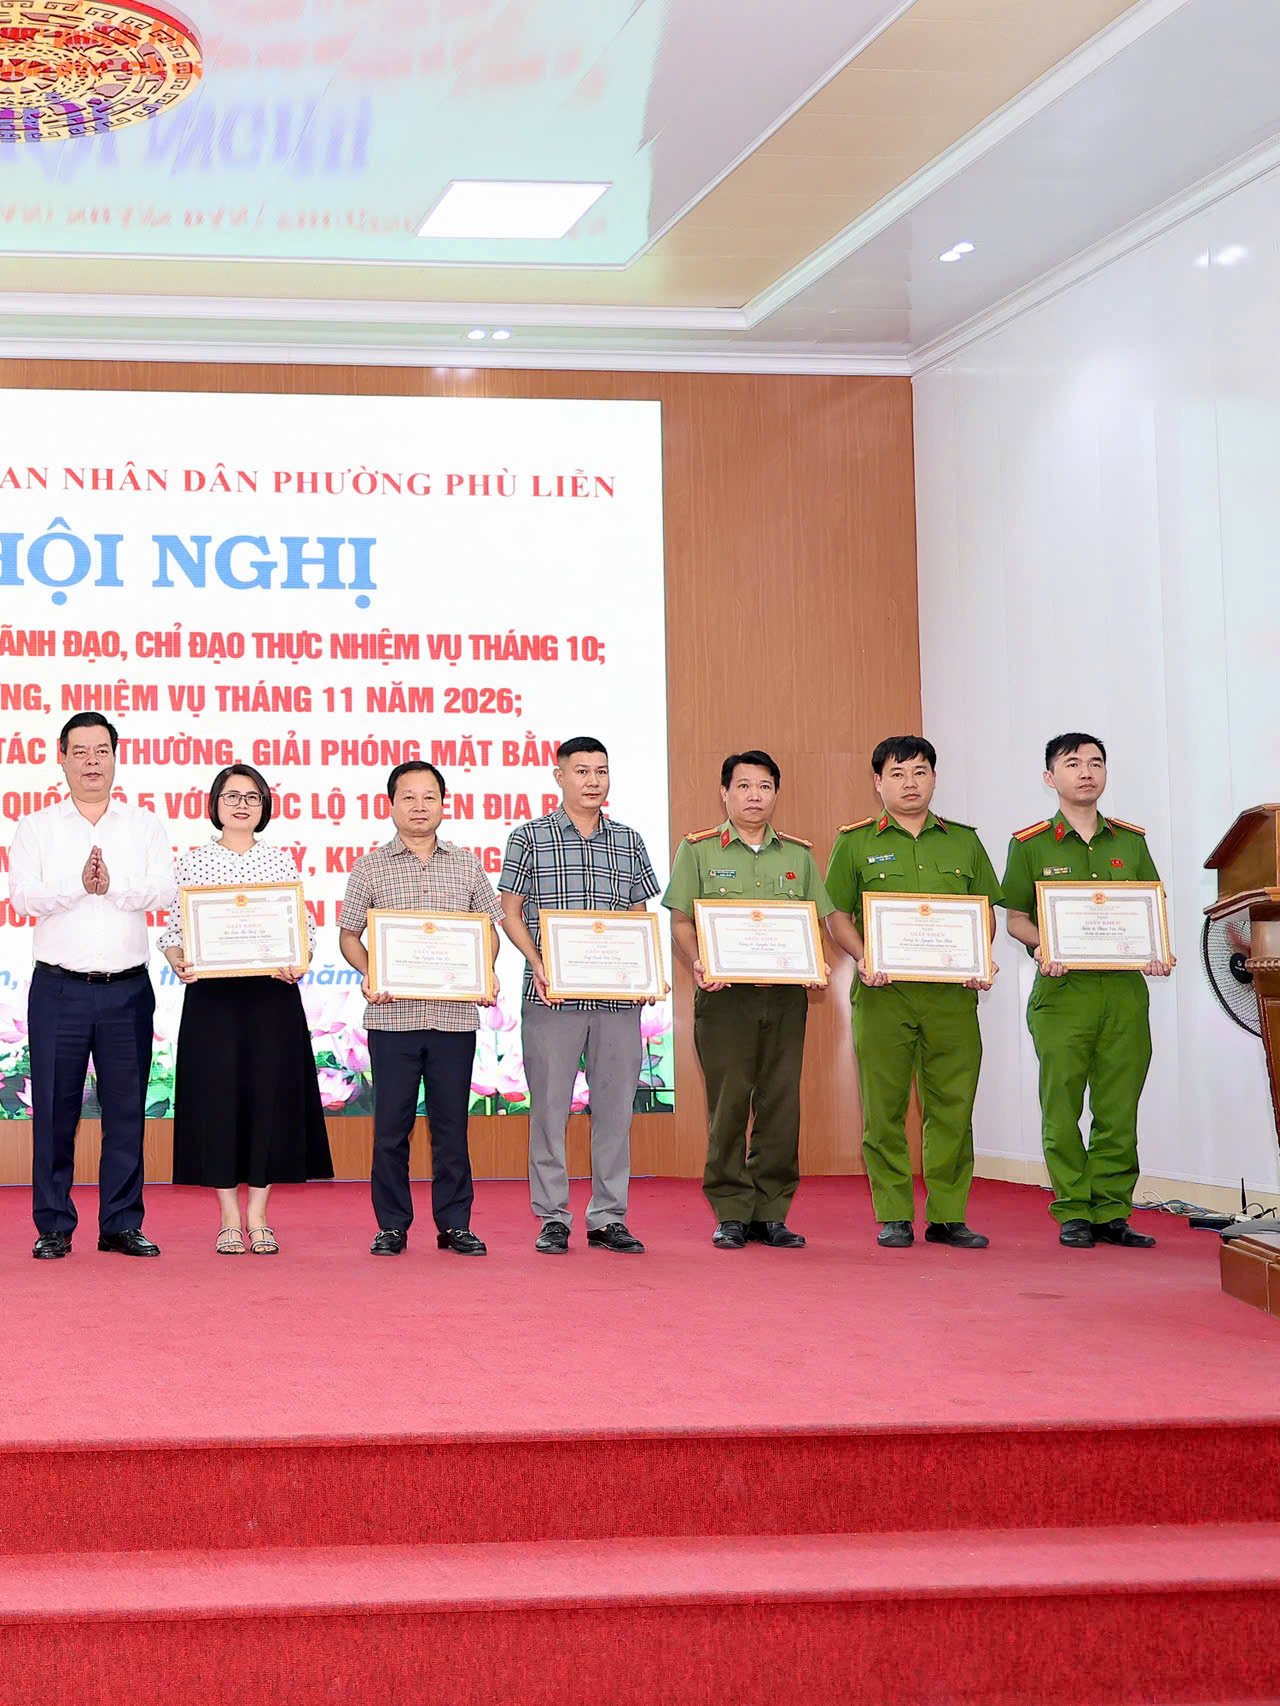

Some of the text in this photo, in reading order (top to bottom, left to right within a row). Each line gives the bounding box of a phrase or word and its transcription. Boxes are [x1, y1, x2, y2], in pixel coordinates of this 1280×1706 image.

[63, 461, 169, 492] NHÂN
[183, 463, 258, 494] DÂN
[273, 465, 432, 496] PHƯỜNG
[446, 467, 518, 497] PHÙ
[152, 535, 376, 608] NGHỊ
[63, 630, 128, 663] ĐẠO,
[136, 622, 182, 658] CHỈ
[189, 632, 245, 664] ĐẠO
[251, 630, 323, 665] THỰC
[330, 628, 420, 666] NHIỆM
[427, 634, 462, 666] VỤ
[468, 629, 558, 661] THÁNG
[566, 636, 606, 664] 10;
[61, 679, 158, 717] NHIỆM
[168, 685, 206, 717] VỤ
[215, 680, 312, 713] THÁNG
[322, 687, 353, 712] 11
[367, 681, 434, 713] NĂM
[444, 687, 522, 716] 2026;
[252, 730, 311, 766] GIẢI
[321, 734, 421, 767] PHÓNG
[431, 735, 493, 772] MẶT
[502, 730, 560, 766] BẰN
[138, 793, 156, 813] 5
[312, 787, 346, 826] LỘ
[357, 793, 391, 819] 10
[483, 793, 532, 826] ĐỊA
